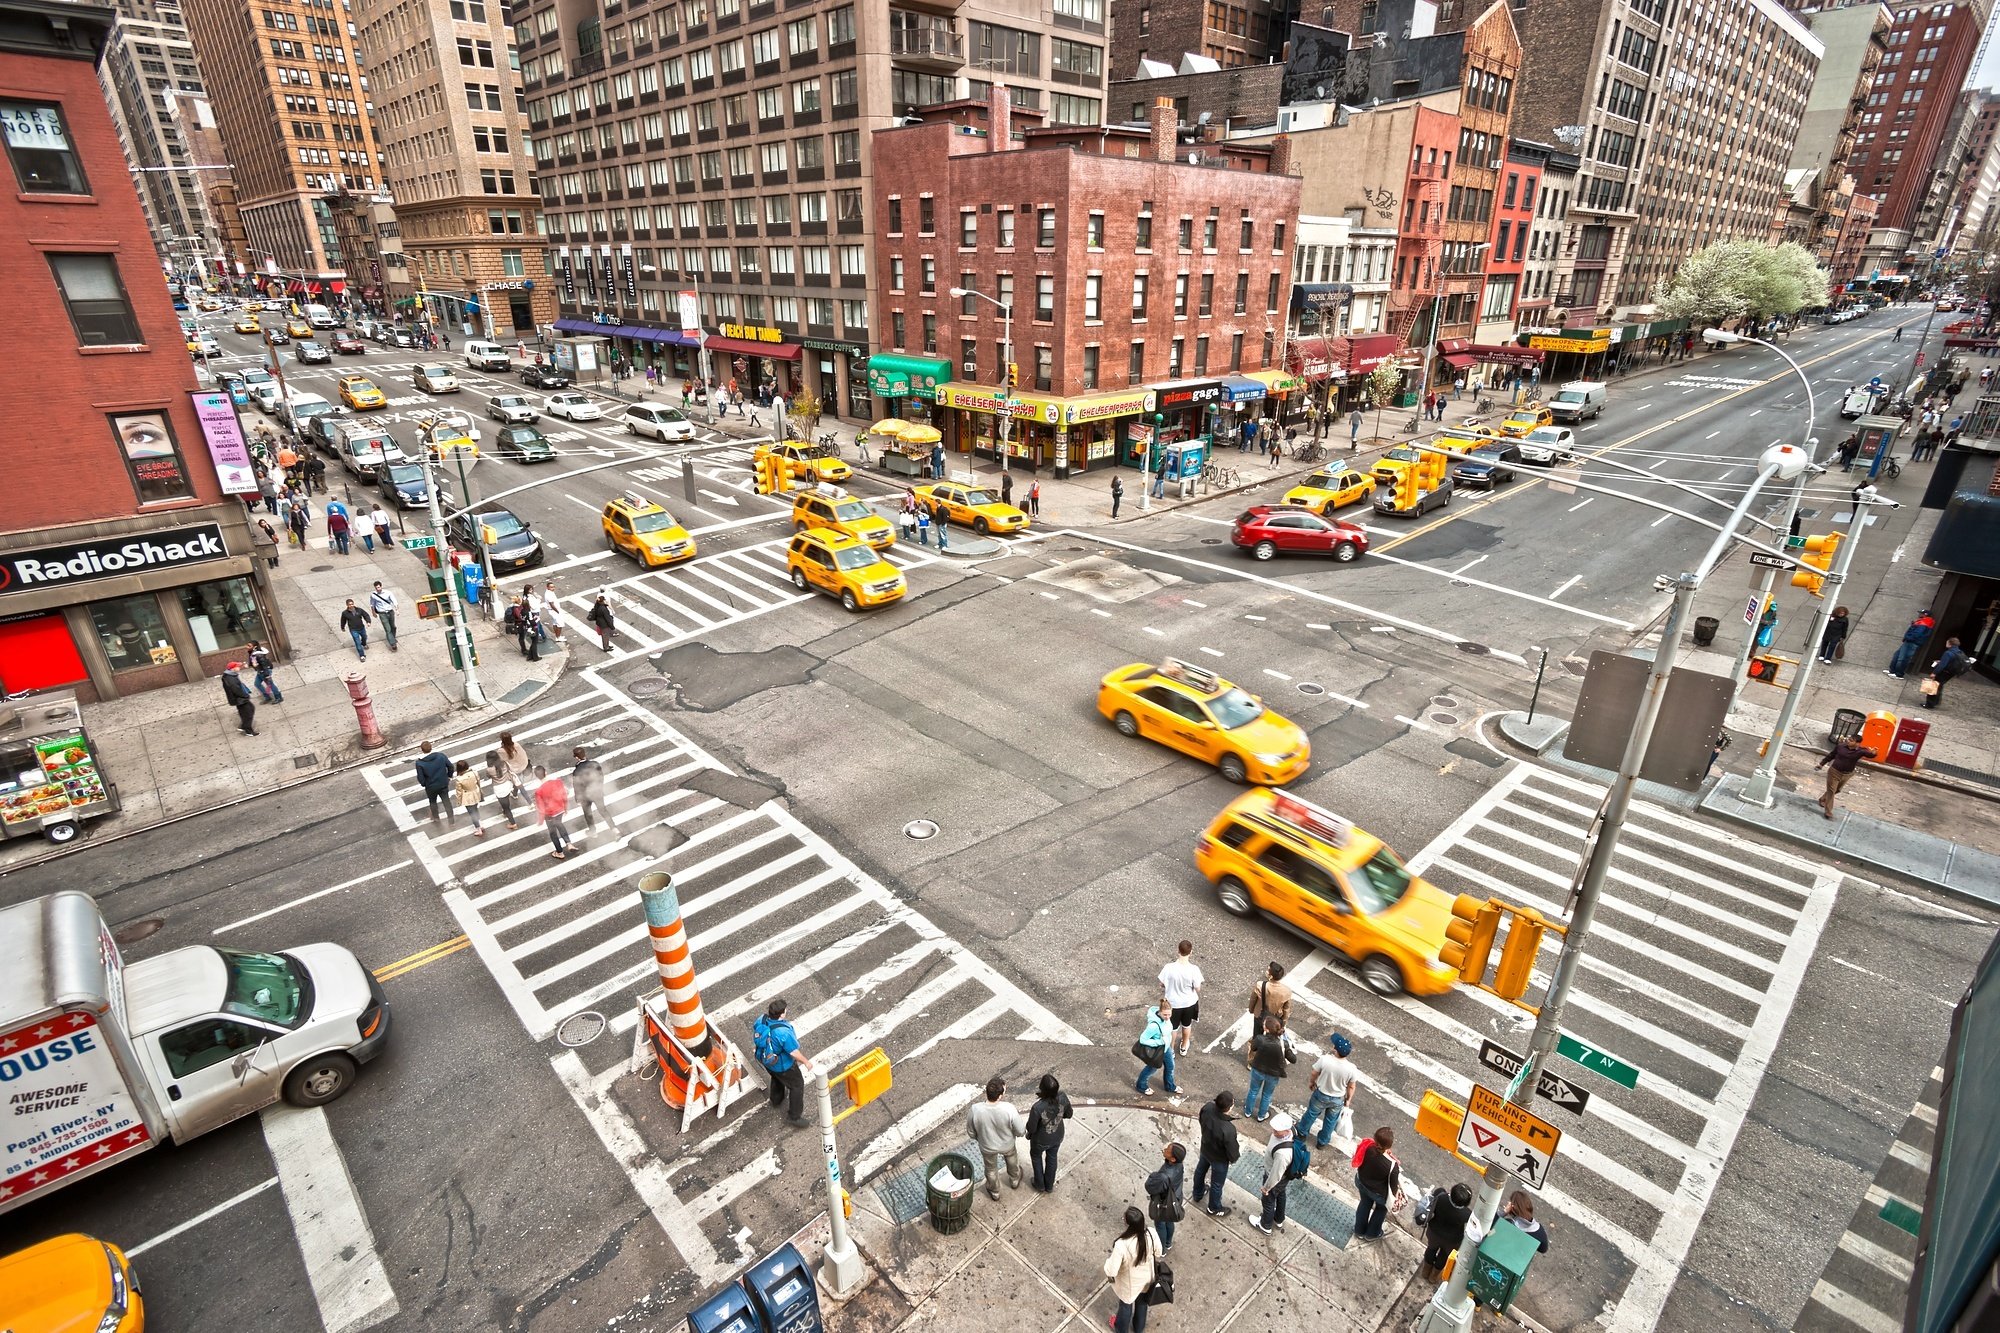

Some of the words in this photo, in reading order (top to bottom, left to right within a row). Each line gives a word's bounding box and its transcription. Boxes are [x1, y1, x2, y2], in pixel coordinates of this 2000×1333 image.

[0, 110, 58, 123] LARS
[2, 121, 63, 136] NORD
[488, 281, 523, 290] CHASE
[606, 266, 615, 295] CHELSEA
[725, 323, 744, 339] BEACH
[757, 327, 782, 343] TANNING
[803, 340, 834, 351] STARBUCKS
[954, 395, 996, 410] CHELSEA
[1163, 386, 1219, 405] pizzagaga
[1080, 404, 1113, 418] CHELSEA
[1113, 400, 1142, 413] PAPAYA
[136, 463, 151, 472] EYE
[151, 461, 174, 470] BROW
[138, 469, 178, 480] THREADING
[406, 540, 414, 548] W
[416, 538, 427, 547] 23
[14, 533, 222, 584] RadioShack
[1771, 558, 1786, 566] WAY
[0, 1031, 96, 1082] OUSE
[1579, 1045, 1593, 1063] 7
[1599, 1058, 1615, 1069] AV
[1494, 1054, 1523, 1075] ONE
[1537, 1077, 1570, 1100] WAY
[9, 1082, 88, 1105] AWESOME
[14, 1095, 80, 1116] SERVICE
[1478, 1090, 1528, 1124] TURNING
[1475, 1101, 1523, 1134] VEHICLES
[6, 1131, 48, 1153] Pearl
[51, 1114, 94, 1136] River,
[96, 1103, 115, 1118] NY
[29, 1117, 109, 1155] 845-735-1508
[6, 1164, 22, 1175] 85
[24, 1158, 38, 1168] N.
[39, 1126, 113, 1161] MIDDLETOWN
[115, 1118, 134, 1130] RD.
[1497, 1143, 1511, 1157] TO
